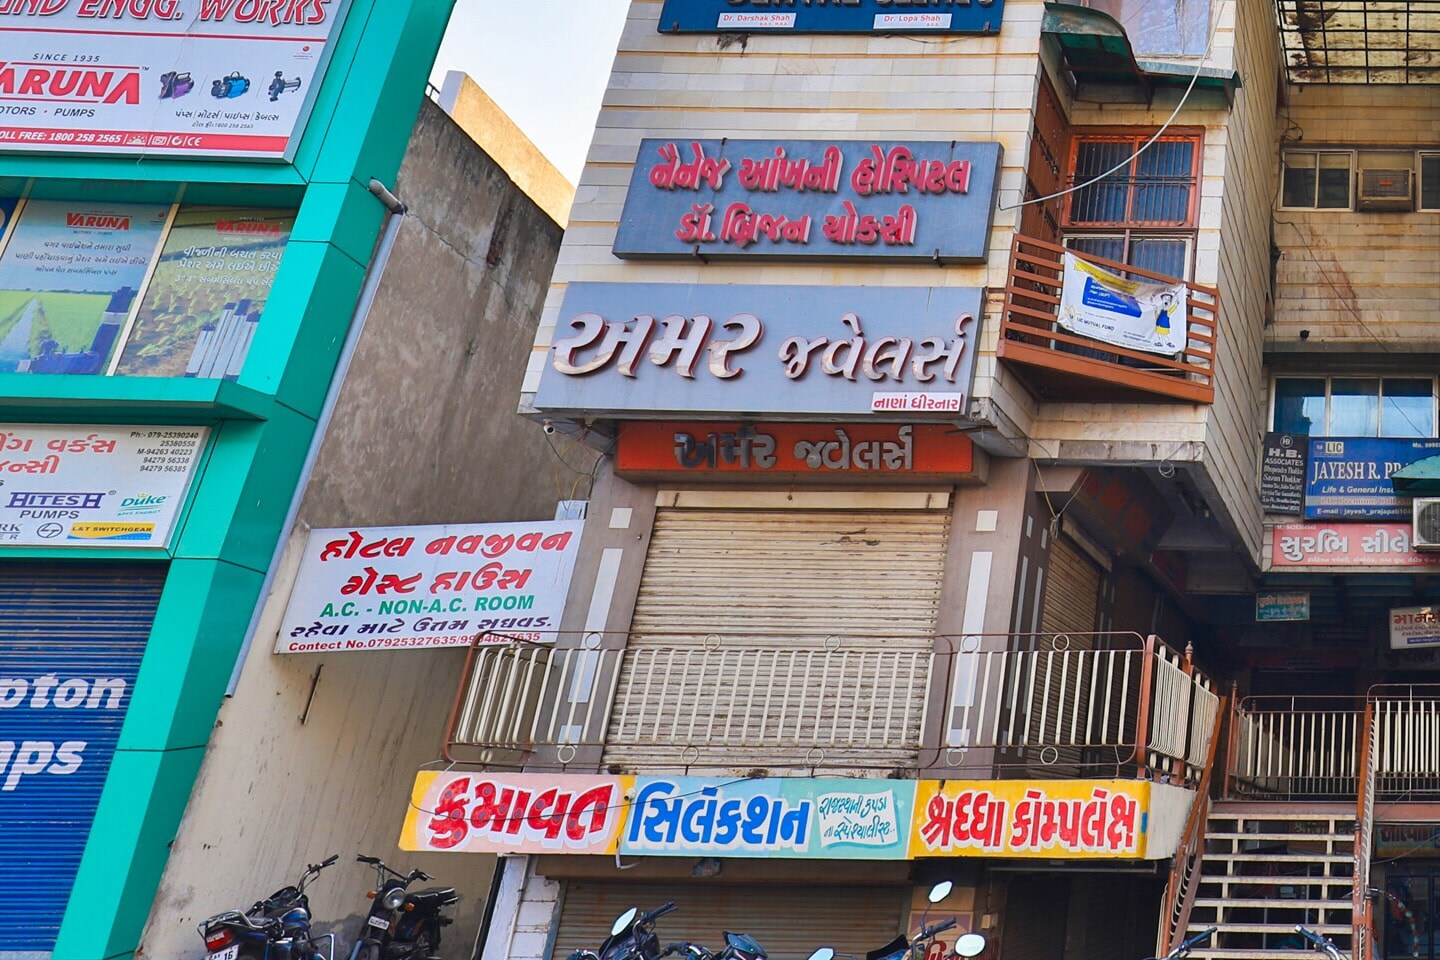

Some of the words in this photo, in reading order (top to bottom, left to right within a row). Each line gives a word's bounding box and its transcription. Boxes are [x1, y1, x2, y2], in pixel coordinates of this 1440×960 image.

[723, 14, 735, 22] Dr.
[736, 14, 769, 22] Darshak
[769, 14, 791, 22] Shah
[898, 15, 919, 23] Lopa
[33, 53, 67, 61] SINCE
[73, 54, 100, 62] 1935
[0, 62, 140, 105] ARUNA
[54, 107, 95, 117] PUMPS
[18, 131, 47, 140] FREE:
[48, 132, 74, 141] 1800
[75, 133, 95, 142] 258
[95, 134, 122, 143] 2565
[737, 145, 845, 193] આંખની
[66, 212, 130, 230] VARUNA
[216, 219, 280, 237] VARUNA
[821, 200, 918, 245] ચોકસી
[551, 311, 764, 380] અમર
[674, 426, 777, 469] અમર
[1268, 448, 1302, 458] H.B.
[1326, 442, 1343, 453] LIC
[1264, 458, 1304, 466] ASSOCIATES
[1312, 461, 1364, 485] JAYESH
[1368, 463, 1381, 480] R.
[1322, 486, 1335, 494] Life
[1346, 486, 1377, 494] General
[5, 492, 105, 508] HITESH
[121, 494, 166, 506] Duke
[19, 510, 80, 519] PUMPS
[319, 531, 415, 562] હોટલ
[424, 531, 573, 559] નવજીવન
[1280, 529, 1349, 562] સુરભિ
[340, 566, 423, 596] ગેસ્ટ
[429, 561, 533, 595] હાઉસ
[319, 602, 359, 618] A.C.
[378, 597, 467, 616] NON-A.C.
[473, 595, 535, 611] ROOM
[289, 621, 349, 638] રહેવા
[357, 618, 406, 634] માટે
[288, 641, 341, 652] Contect
[428, 777, 614, 849] કુમાવત
